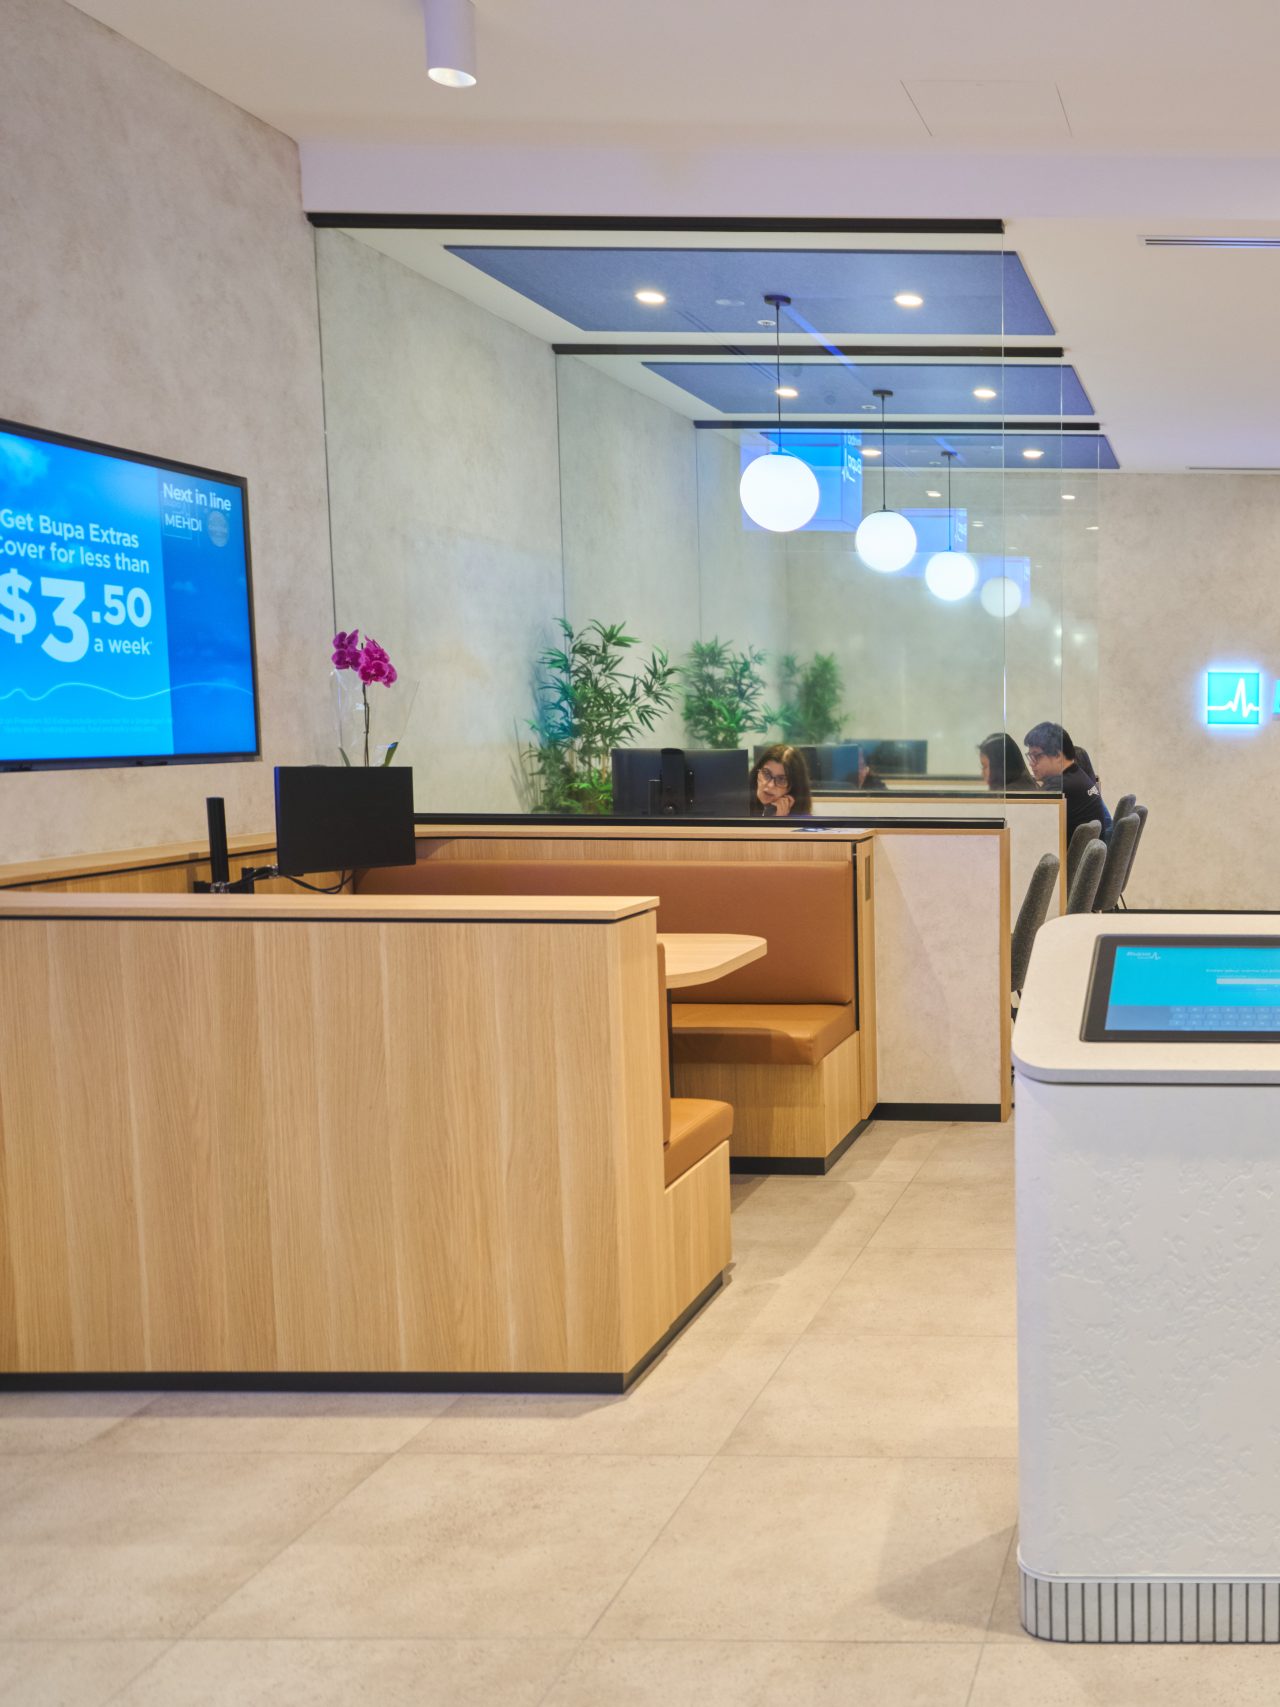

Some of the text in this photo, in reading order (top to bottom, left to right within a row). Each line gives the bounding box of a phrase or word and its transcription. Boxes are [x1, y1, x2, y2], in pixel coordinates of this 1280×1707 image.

[163, 482, 232, 512] Next in line
[0, 508, 140, 549] Get Bupa Extras
[164, 513, 202, 532] MEHDI
[50, 542, 75, 563] for
[80, 546, 111, 569] less
[115, 552, 150, 574] than
[94, 637, 104, 653] a
